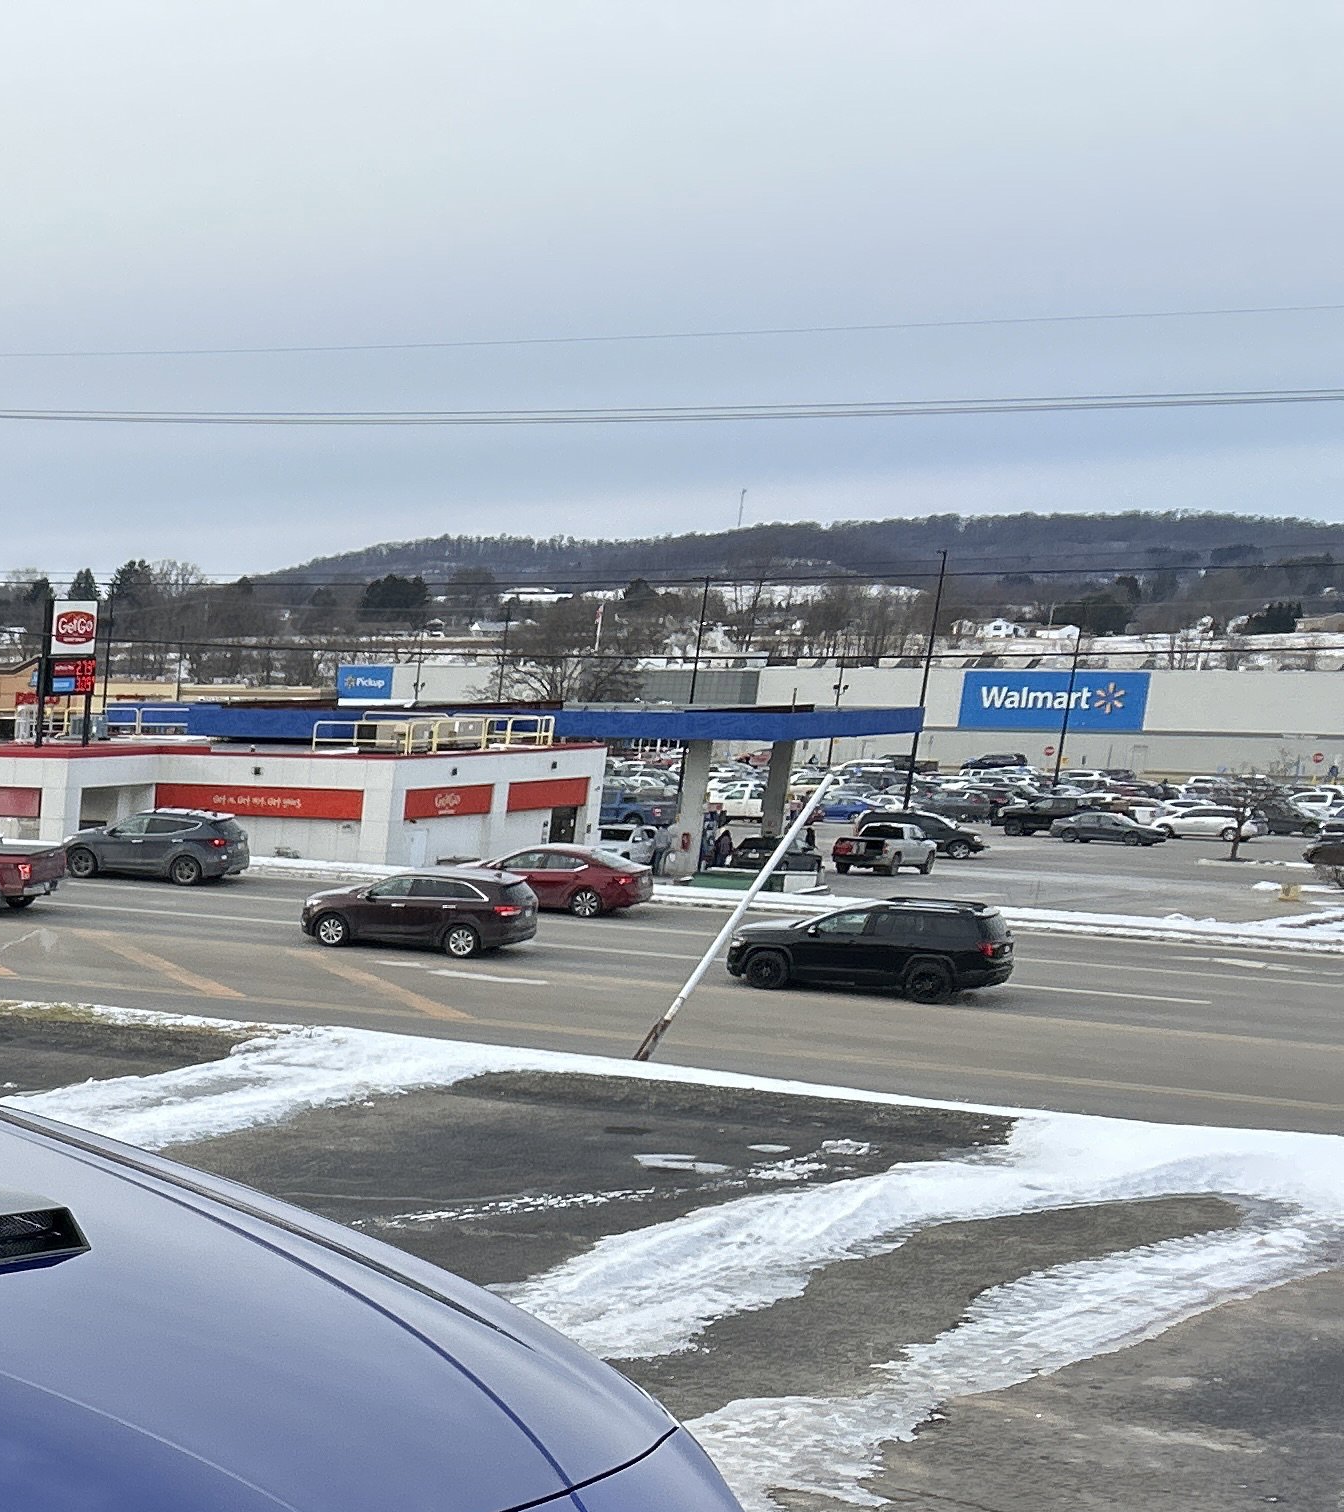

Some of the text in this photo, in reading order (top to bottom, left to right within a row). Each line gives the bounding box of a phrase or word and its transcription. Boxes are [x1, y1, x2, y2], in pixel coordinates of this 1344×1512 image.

[58, 617, 93, 634] GetGo
[356, 677, 385, 689] Pickup
[981, 686, 1092, 709] Walmart
